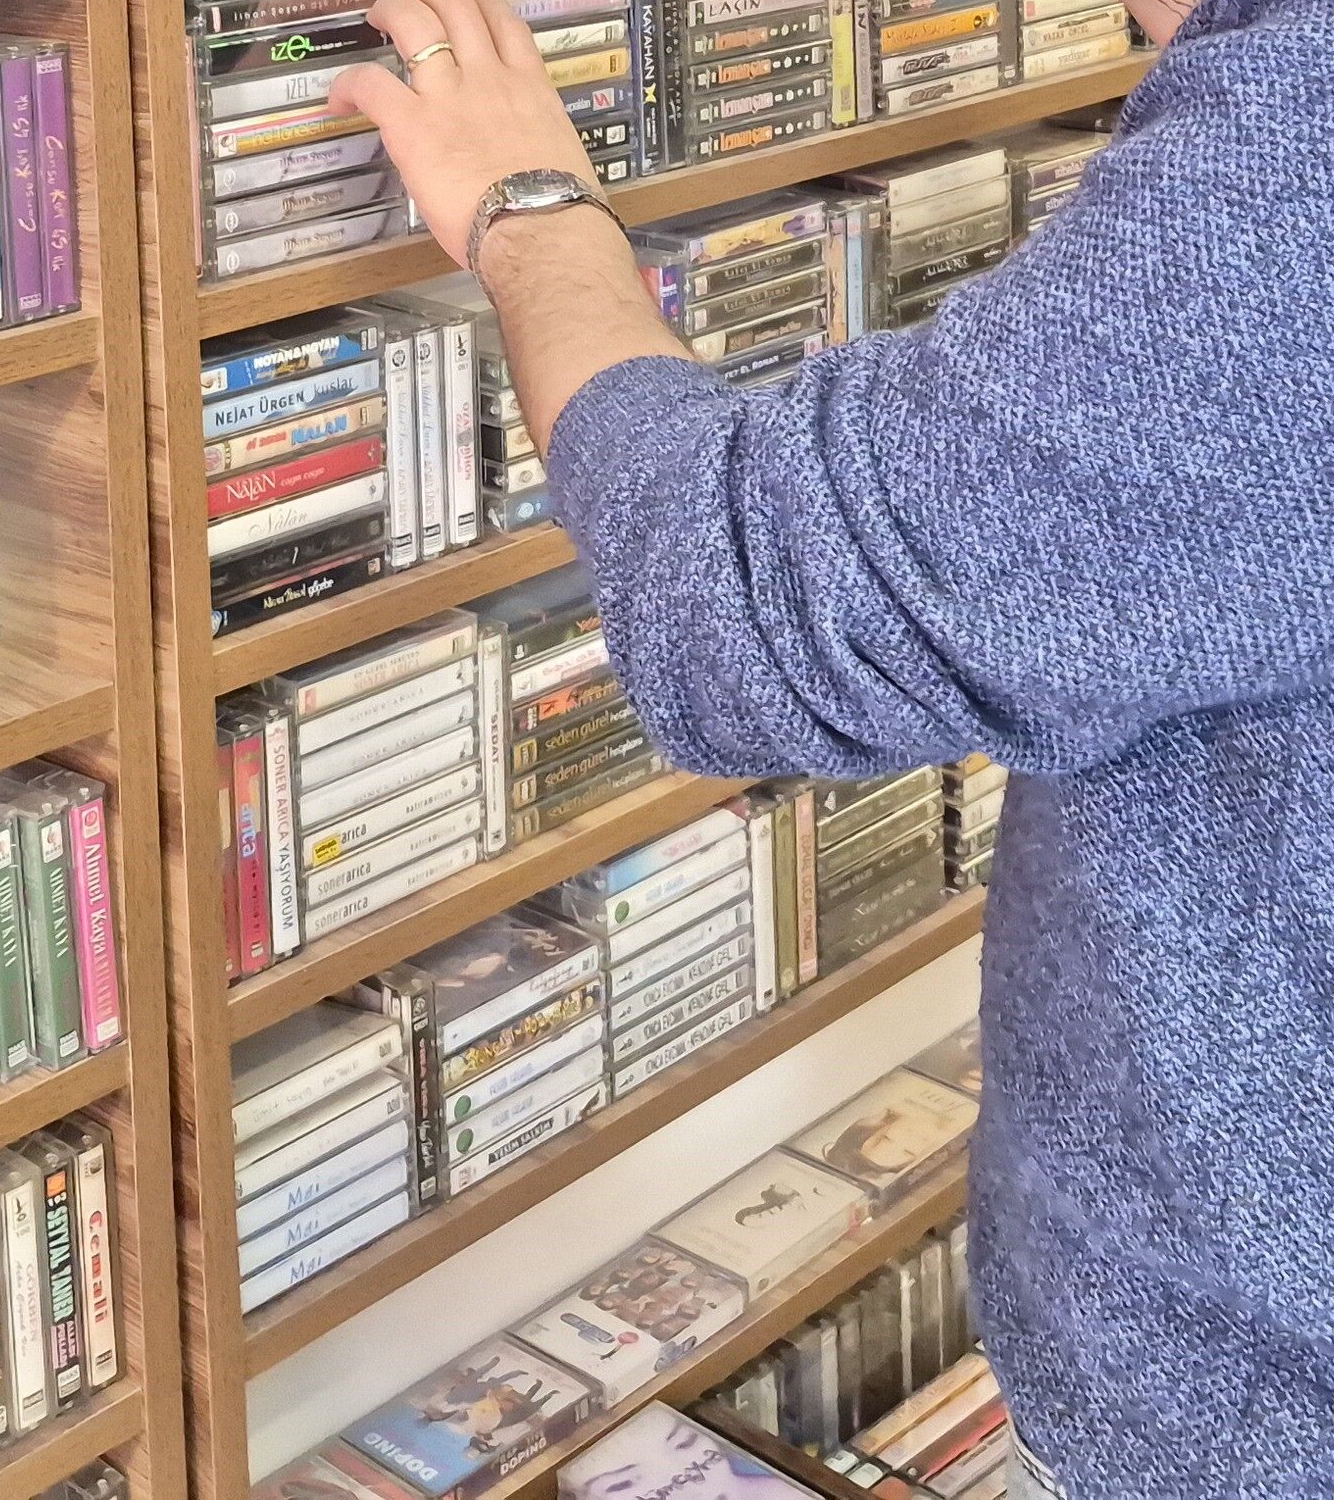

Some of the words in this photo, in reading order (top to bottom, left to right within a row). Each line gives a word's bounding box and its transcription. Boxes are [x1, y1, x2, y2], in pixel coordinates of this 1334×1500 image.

[641, 3, 656, 81] KAYAHAN
[363, 1430, 439, 1484] DOPING
[499, 1435, 548, 1478] DOPING
